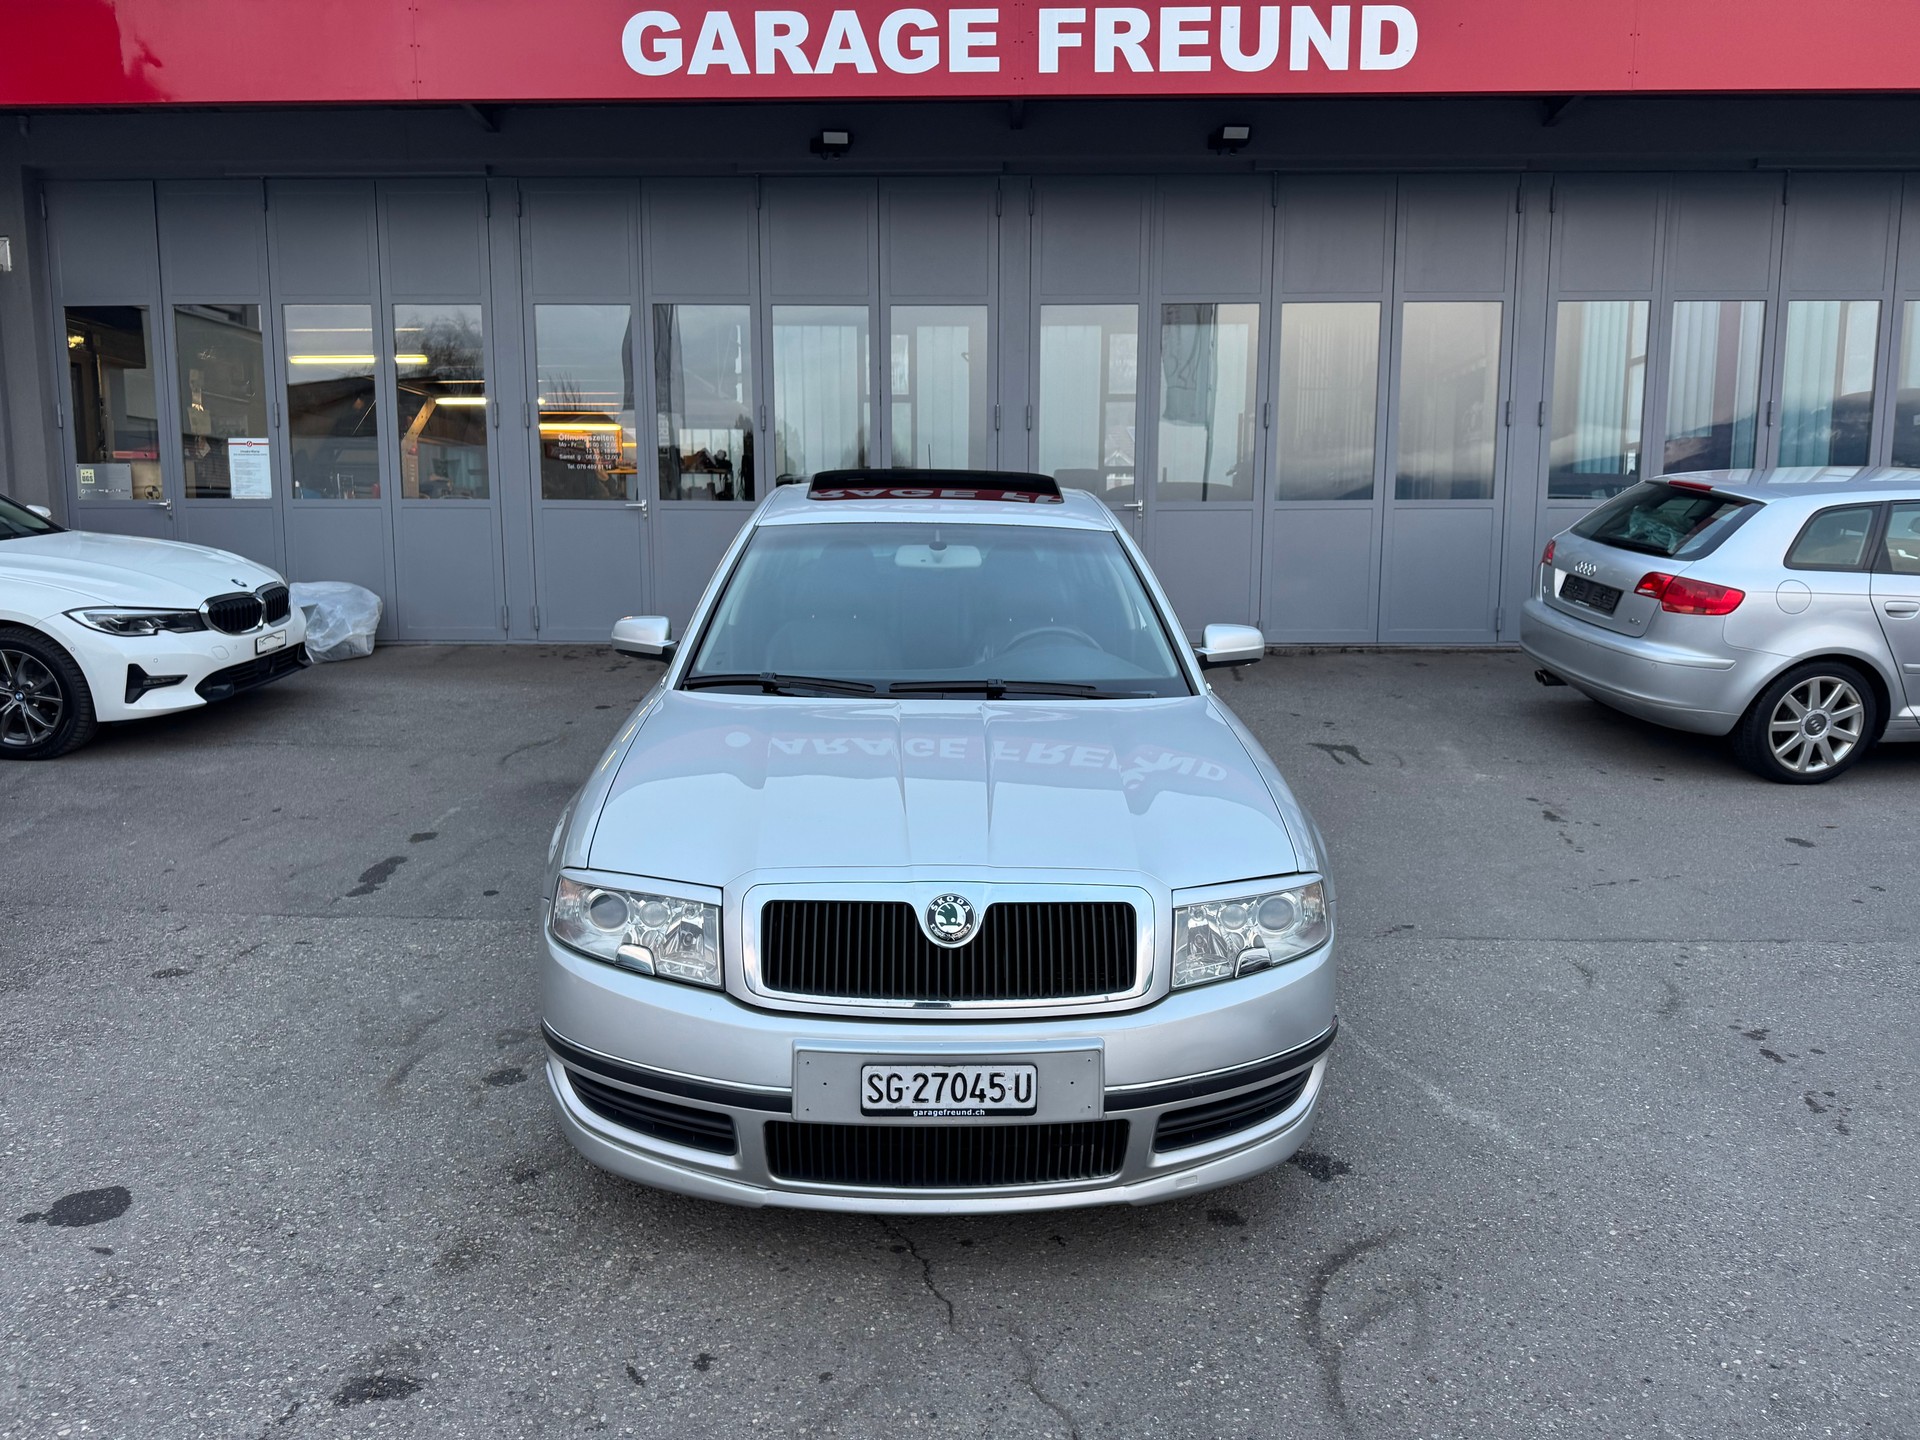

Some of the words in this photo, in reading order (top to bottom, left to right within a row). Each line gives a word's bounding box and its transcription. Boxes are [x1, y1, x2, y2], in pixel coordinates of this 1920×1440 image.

[621, 8, 1000, 76] GARAGE
[1037, 4, 1419, 74] FREUND
[913, 1109, 985, 1117] garagefreund.ch
